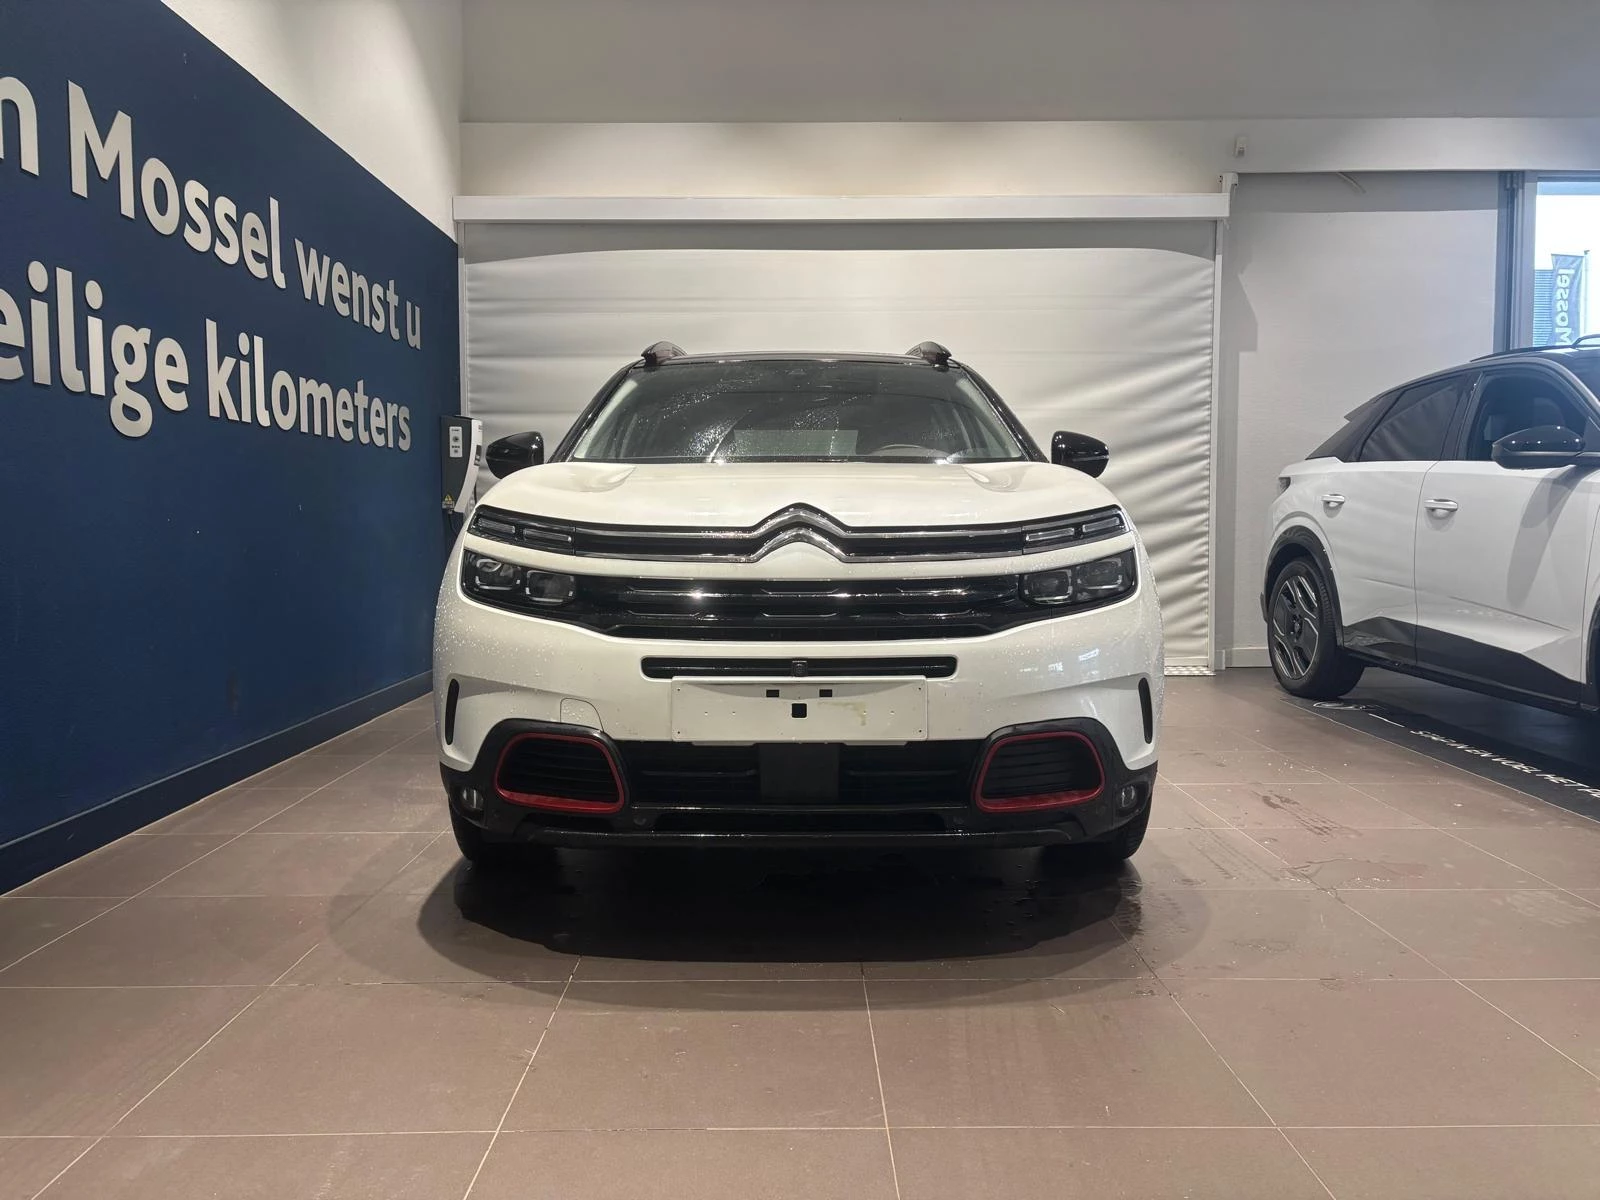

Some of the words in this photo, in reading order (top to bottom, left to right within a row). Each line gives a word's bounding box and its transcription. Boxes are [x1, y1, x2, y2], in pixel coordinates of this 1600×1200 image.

[67, 80, 286, 289] Mossel
[294, 238, 400, 341] wenst
[406, 300, 421, 350] u
[205, 318, 411, 451] kilometers
